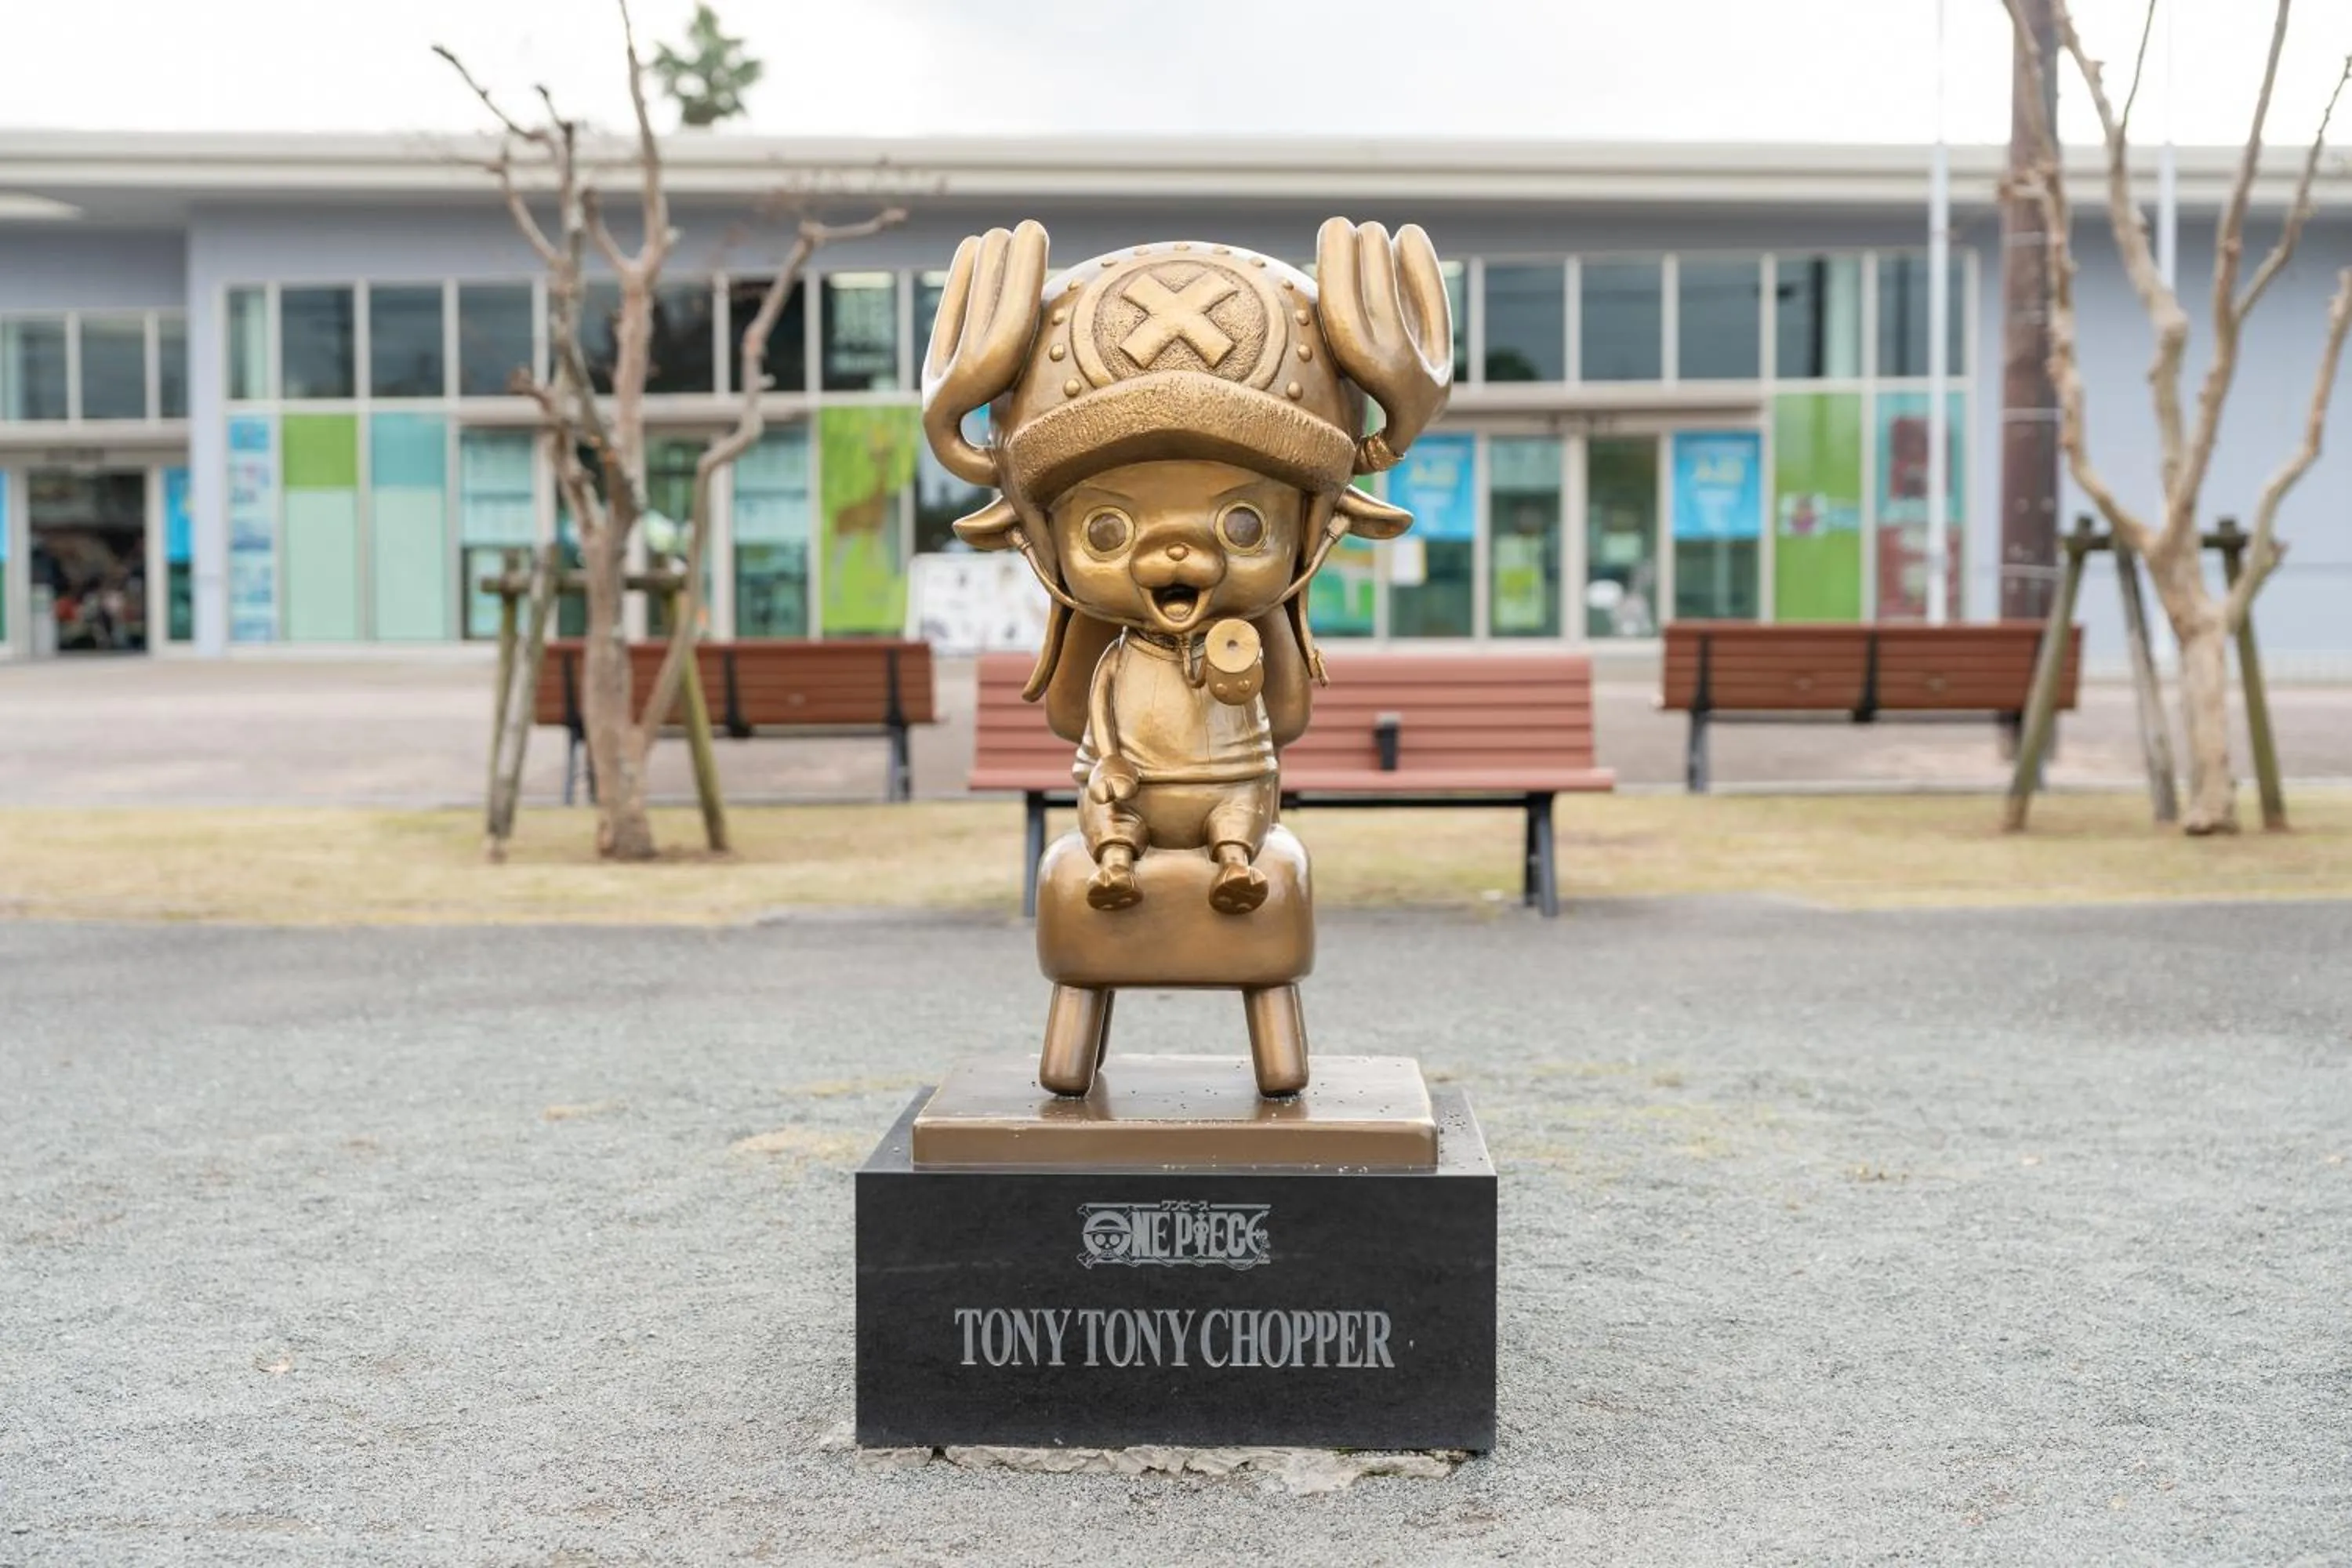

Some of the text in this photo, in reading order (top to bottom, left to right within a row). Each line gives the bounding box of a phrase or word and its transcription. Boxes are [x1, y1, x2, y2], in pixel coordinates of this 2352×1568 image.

[1160, 1200, 1210, 1211] ワンピース
[1083, 1210, 1270, 1258] ONE PIECE
[954, 1308, 1396, 1368] TONY TONY CHOPPER
